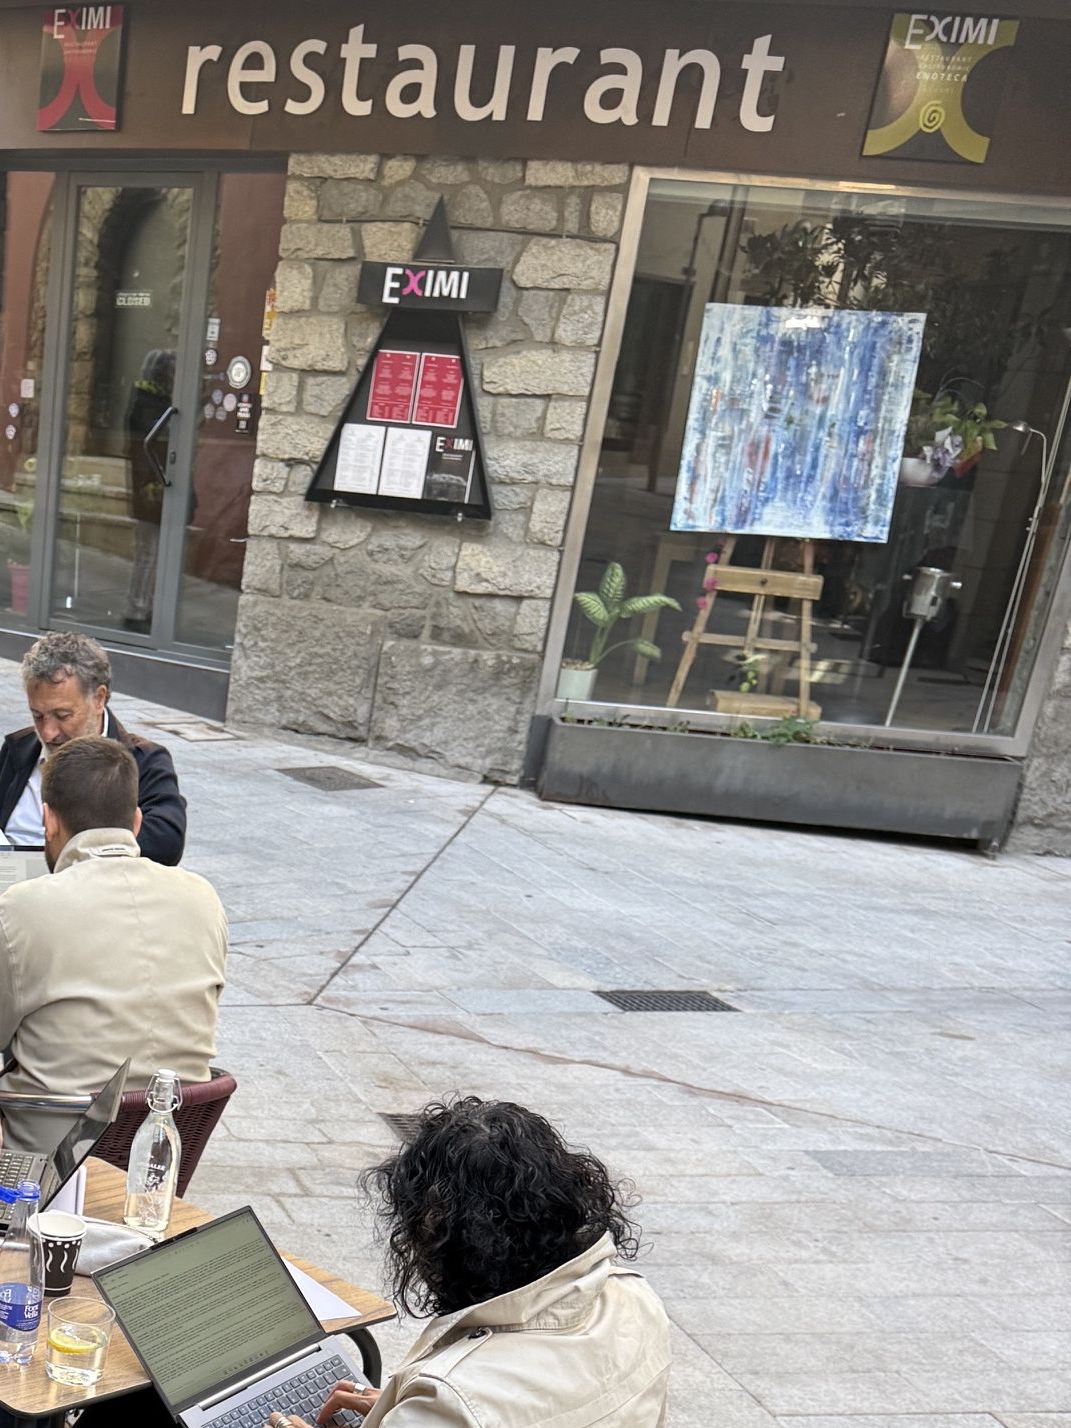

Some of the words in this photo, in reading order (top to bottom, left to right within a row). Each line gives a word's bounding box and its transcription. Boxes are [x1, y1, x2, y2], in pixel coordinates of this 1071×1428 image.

[53, 6, 112, 39] EXIMI
[904, 14, 1000, 50] EXIMI
[181, 23, 785, 132] restaurant
[381, 266, 470, 304] EXIMI
[435, 436, 474, 452] EXIMI
